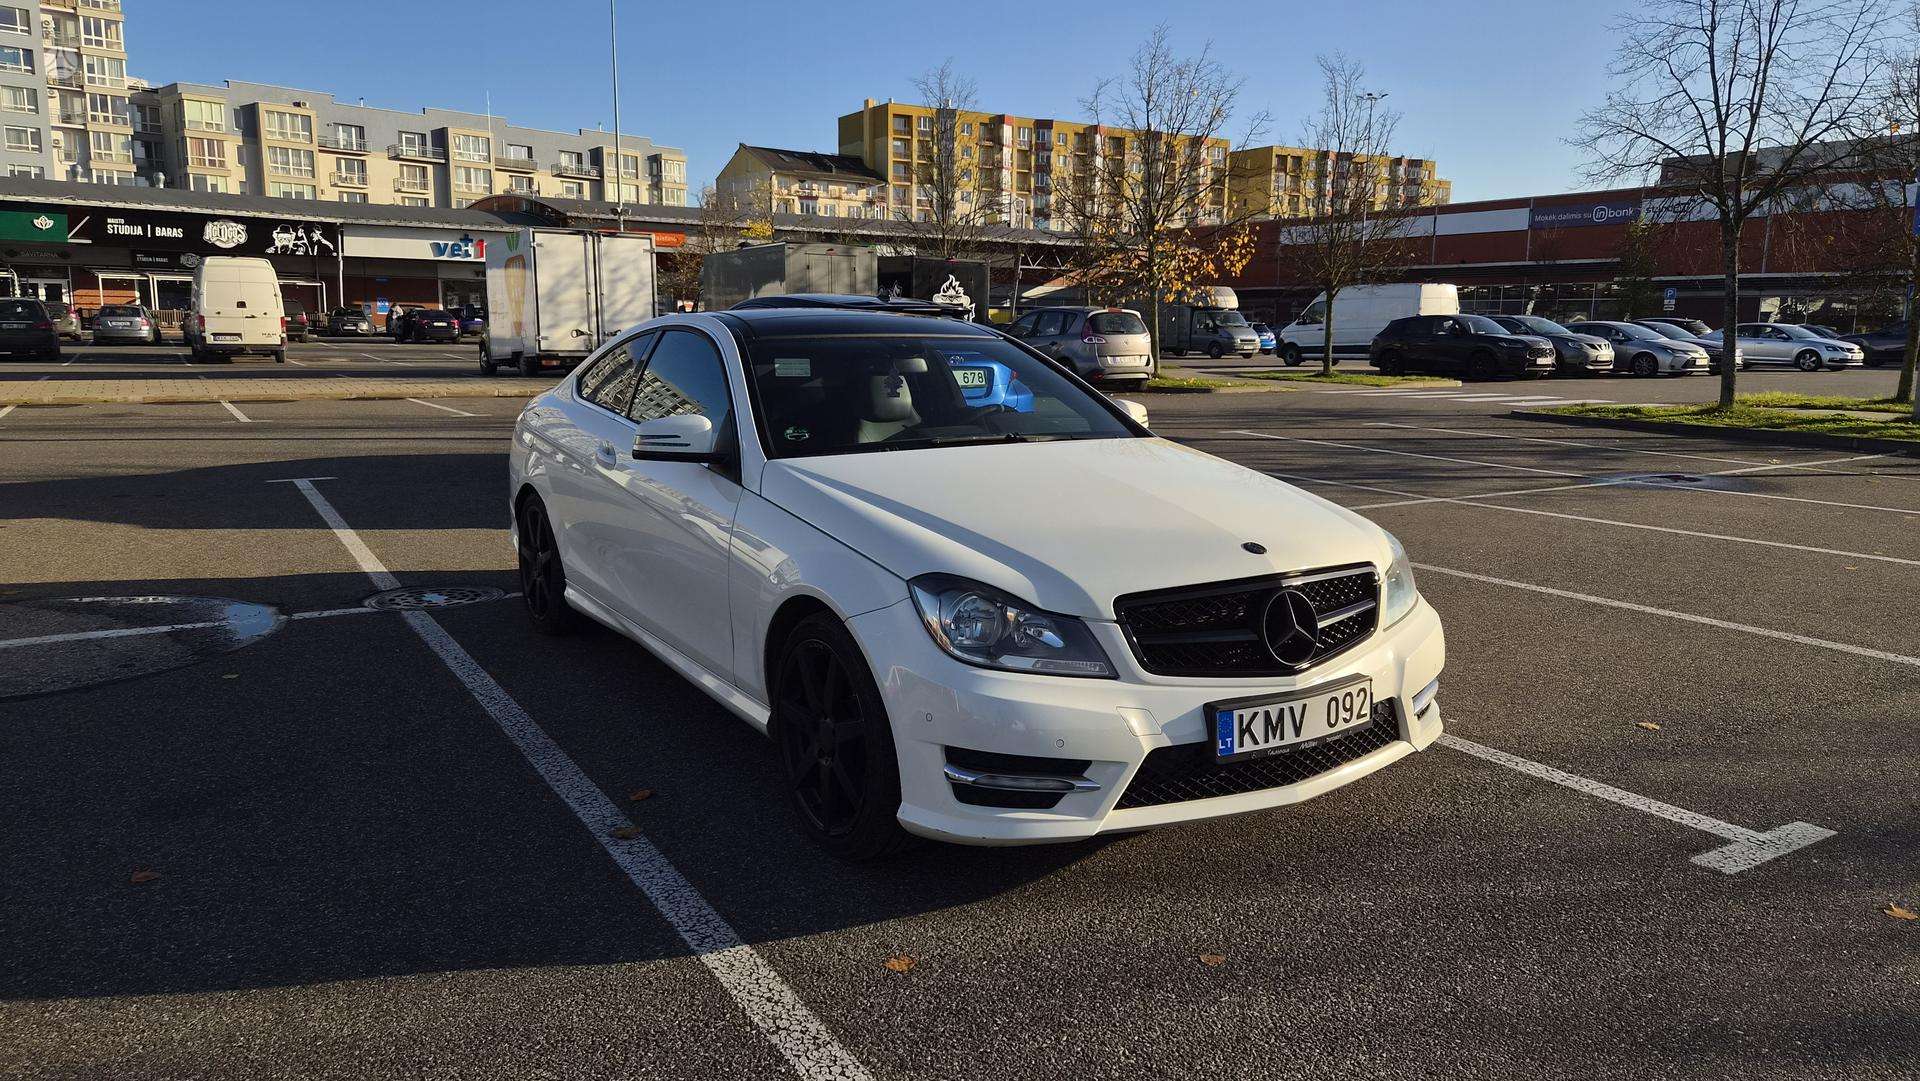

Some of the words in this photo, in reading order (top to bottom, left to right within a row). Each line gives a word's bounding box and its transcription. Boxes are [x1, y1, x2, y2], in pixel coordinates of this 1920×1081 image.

[107, 224, 143, 236] STUDIJA
[155, 227, 184, 238] BARAS
[962, 372, 984, 384] 678
[1218, 737, 1233, 749] LT
[1237, 702, 1308, 748] KMV
[1326, 687, 1368, 729] 092
